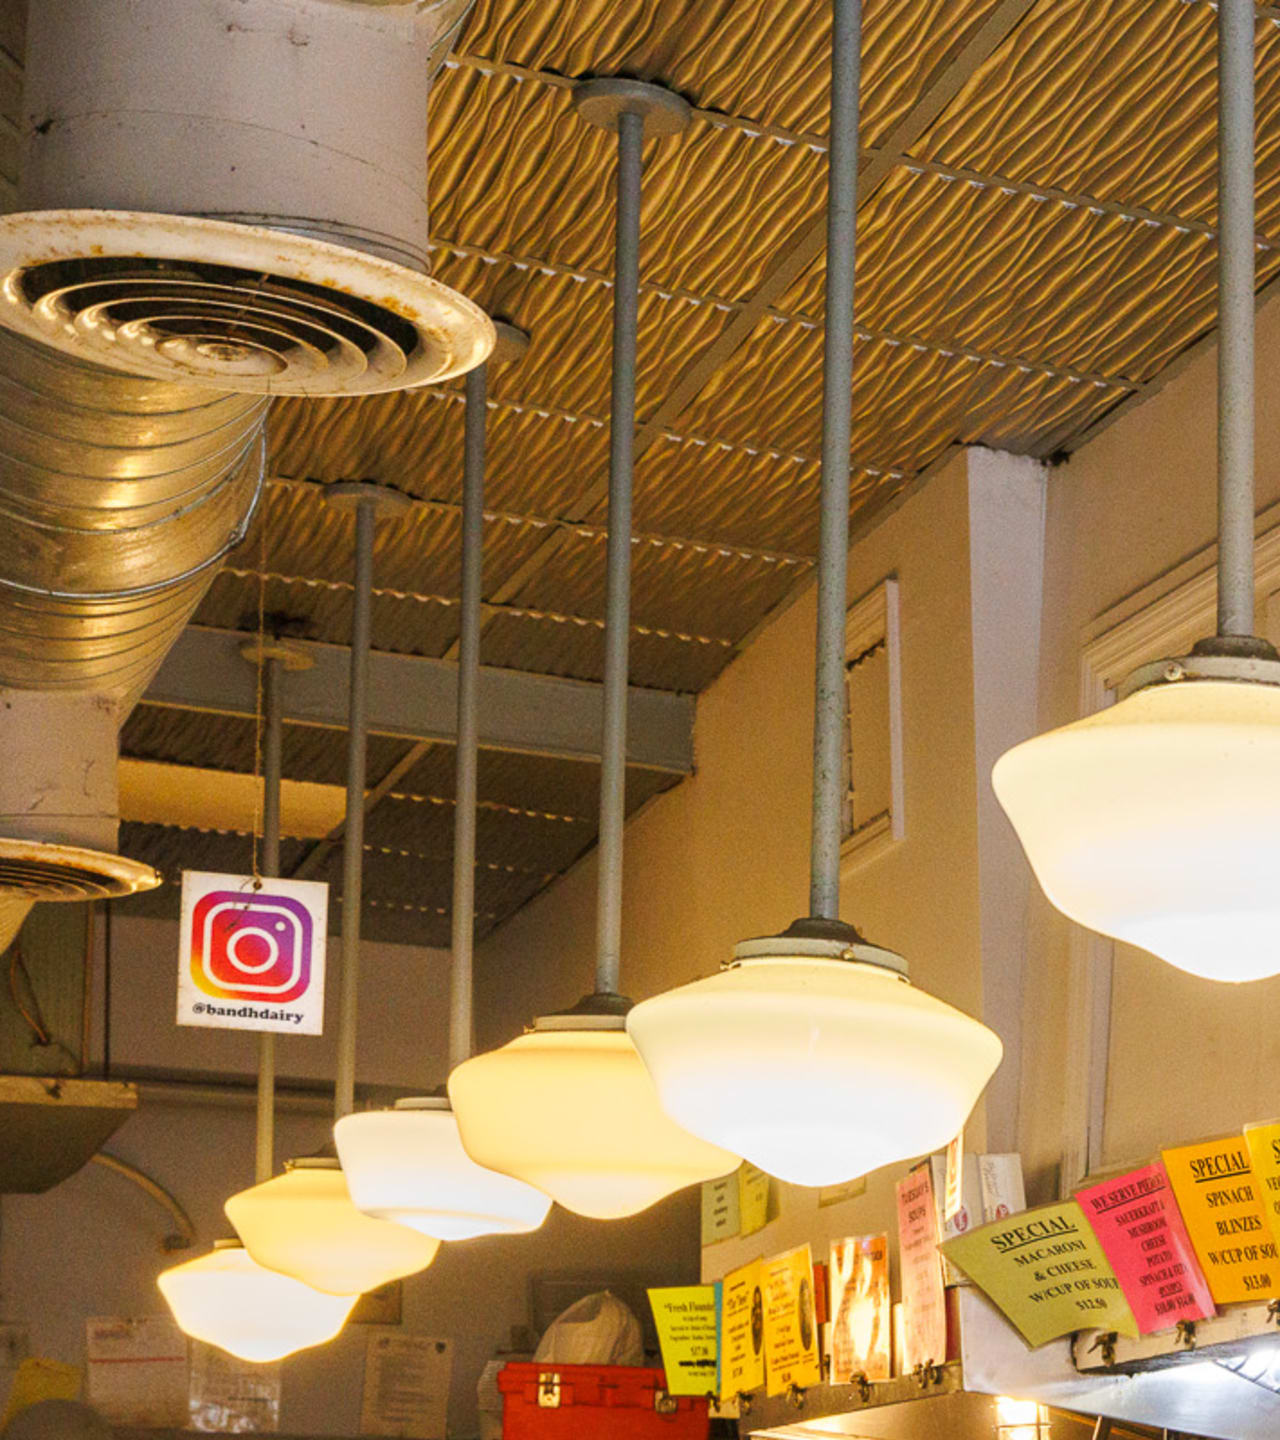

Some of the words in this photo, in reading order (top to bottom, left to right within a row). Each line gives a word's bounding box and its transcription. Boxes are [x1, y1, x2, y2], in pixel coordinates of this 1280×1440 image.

[191, 1002, 305, 1024] @bandhdairy
[1189, 1151, 1251, 1181] SPECIAL
[1107, 1182, 1138, 1205] SERVE
[1205, 1184, 1255, 1210] SPINACH
[990, 1215, 1077, 1252] SPECIAL
[1215, 1214, 1264, 1237] BLINZES
[1013, 1239, 1087, 1268] MACARONI
[1207, 1244, 1244, 1268] W/CUP
[1046, 1258, 1098, 1279] CHEESE
[1028, 1281, 1073, 1304] W/CUP
[1242, 1274, 1273, 1292] $13.00
